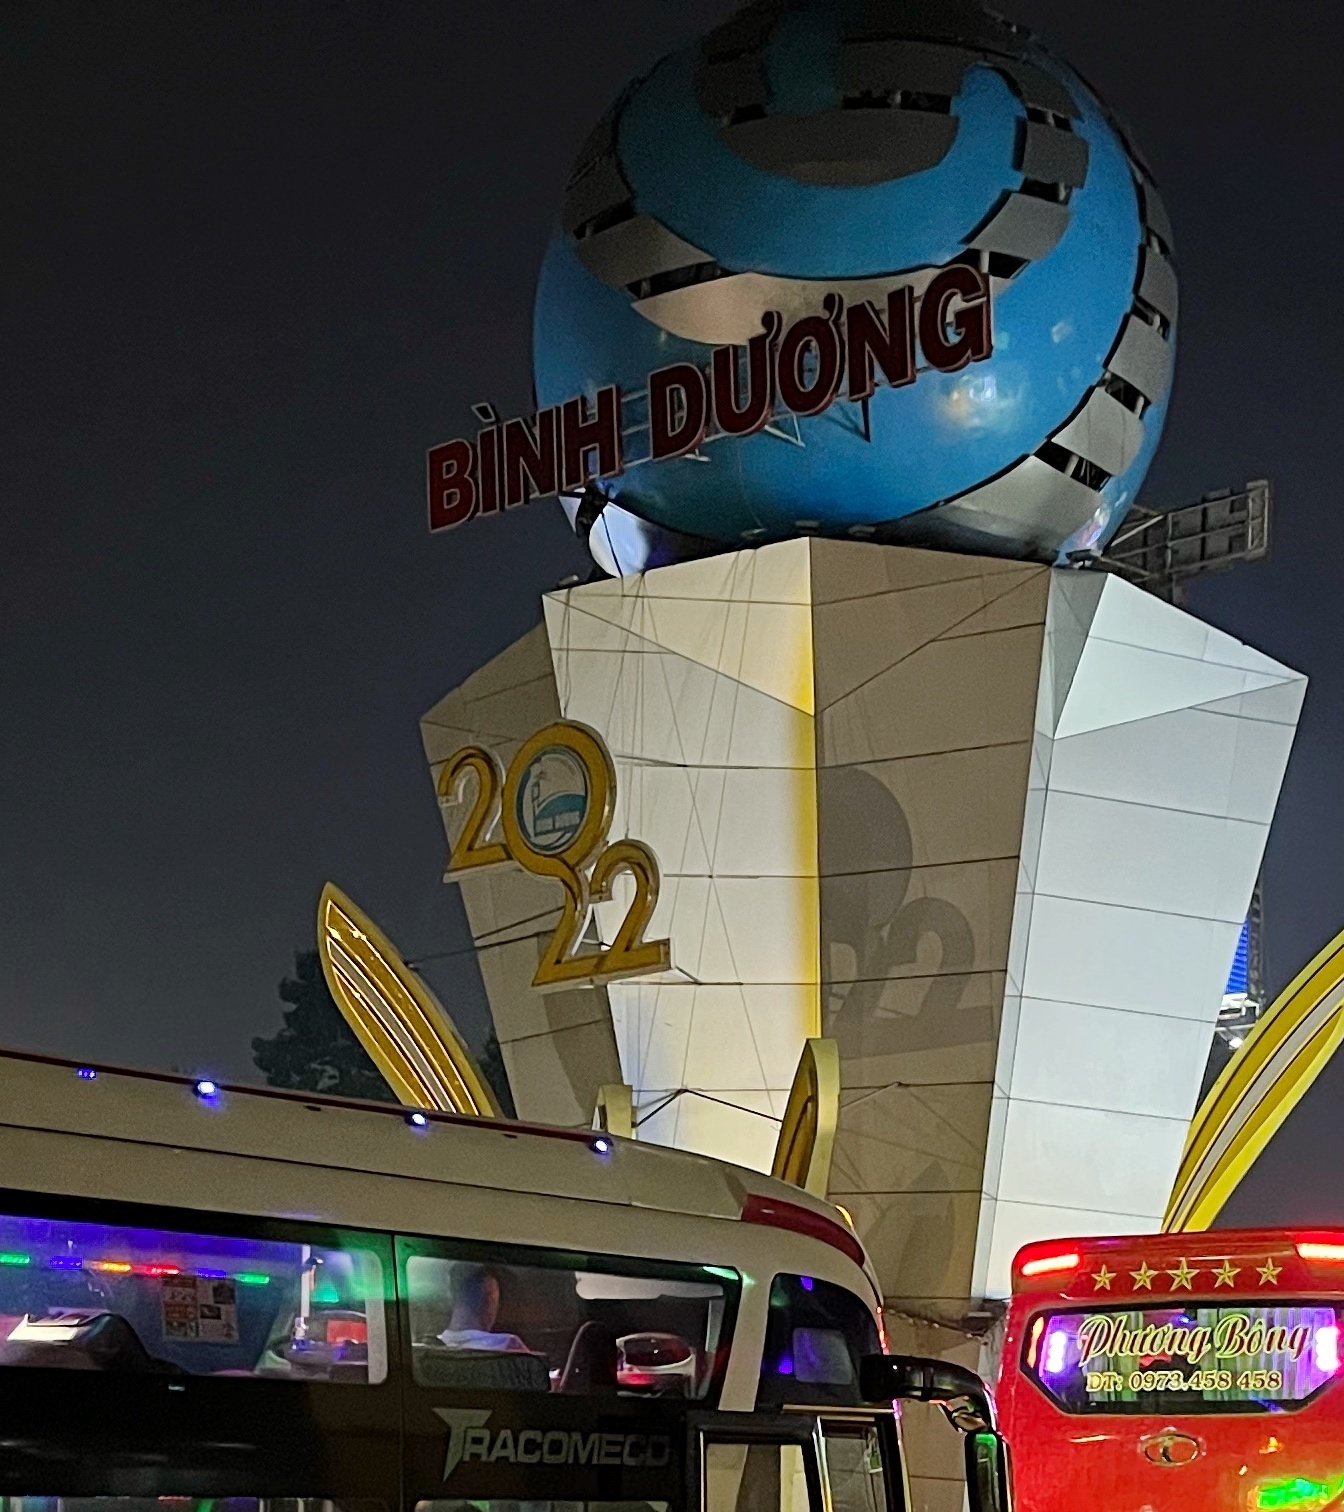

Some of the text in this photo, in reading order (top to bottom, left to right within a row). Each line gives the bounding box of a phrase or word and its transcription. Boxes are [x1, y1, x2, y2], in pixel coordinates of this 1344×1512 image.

[427, 263, 996, 532] BÌNH DƯƠNG
[1077, 1314, 1311, 1367] Phương Bông
[1130, 1370, 1232, 1392] 0973.458
[1237, 1370, 1283, 1391] 458
[432, 1407, 670, 1482] TRACOMECO
